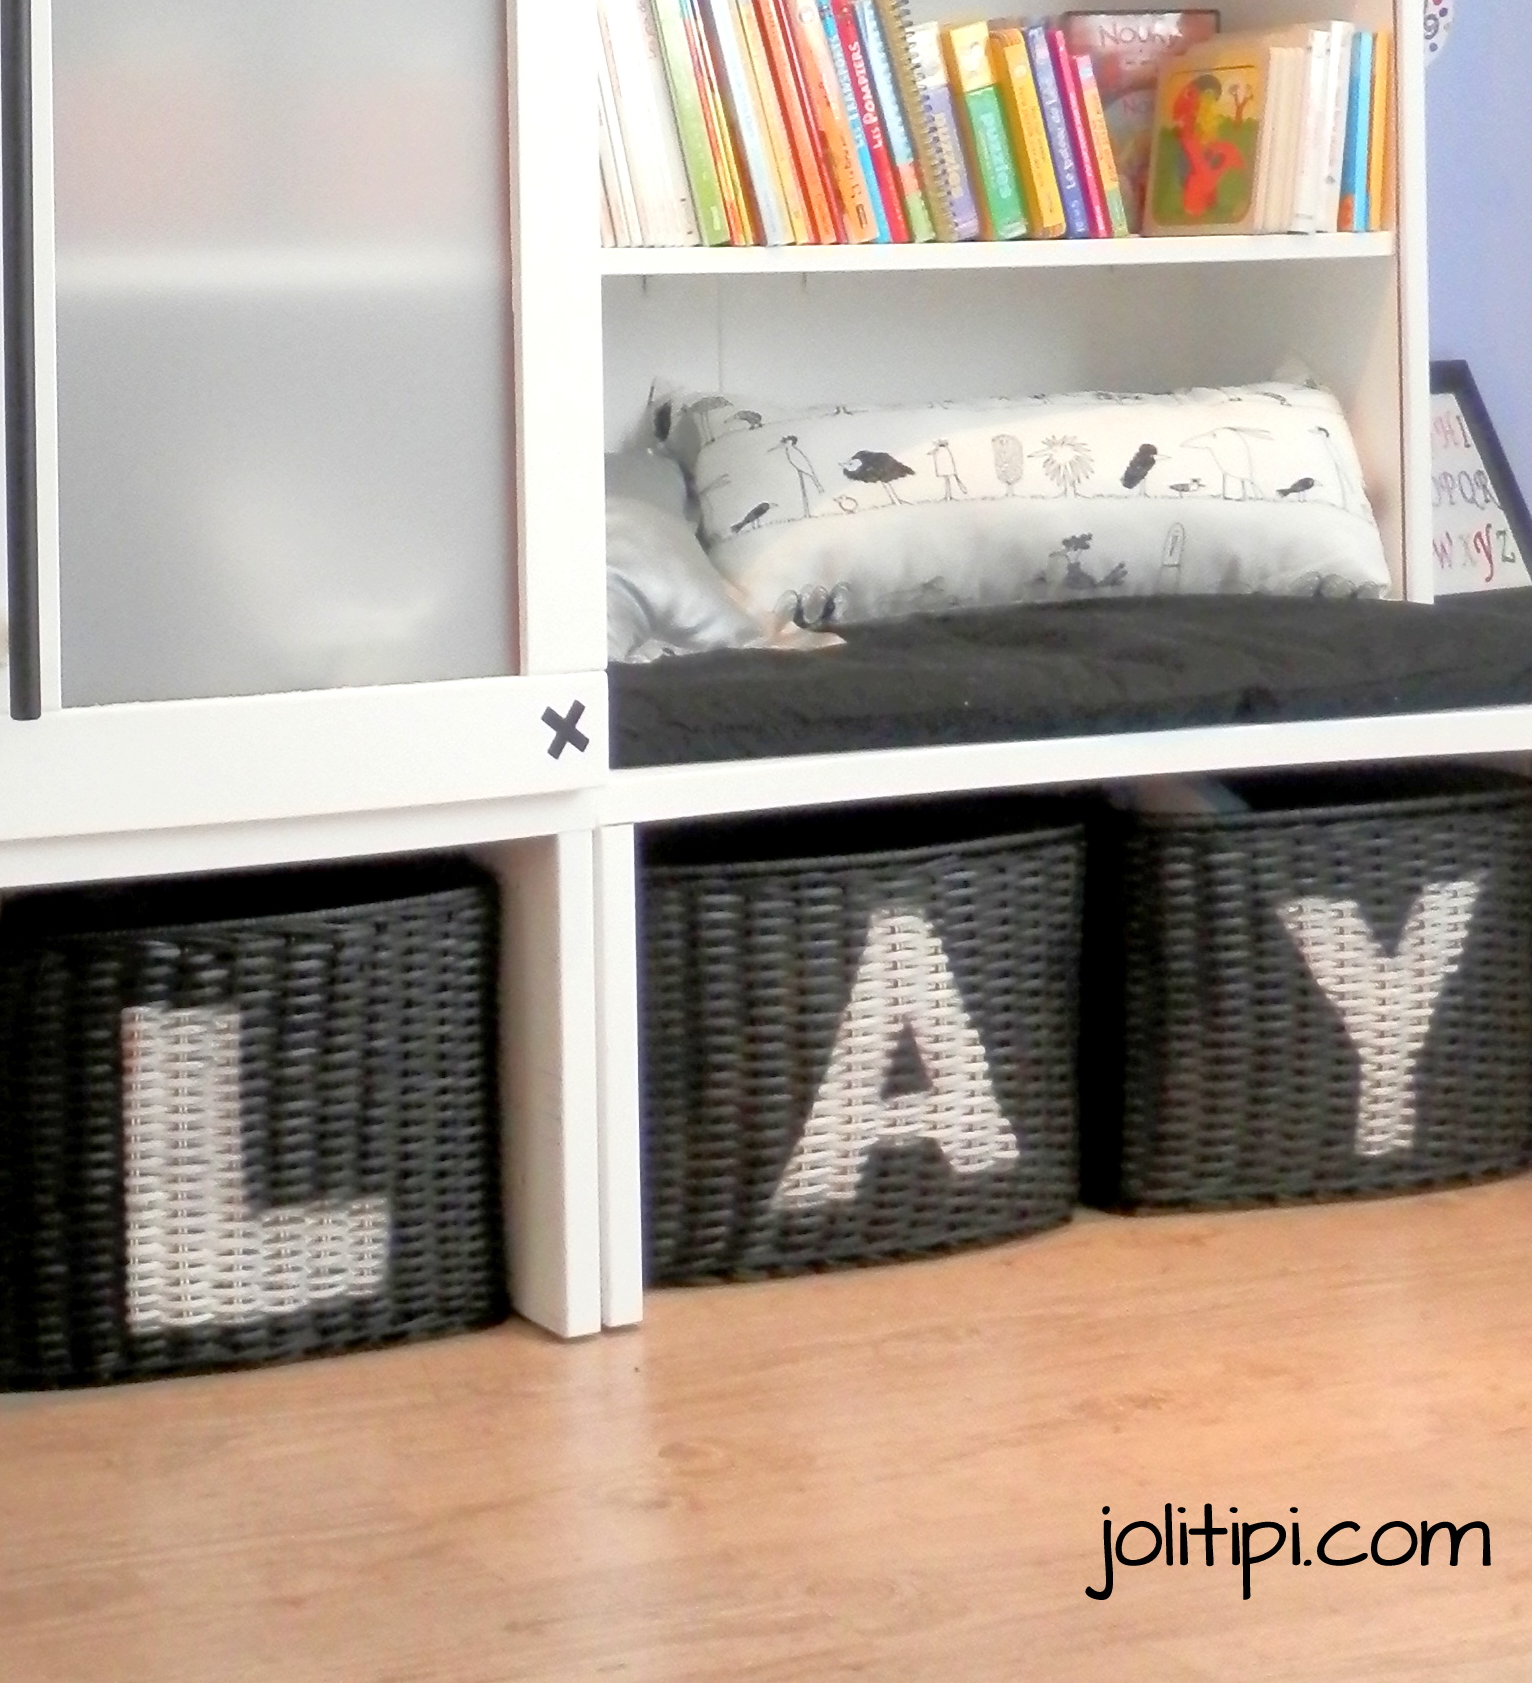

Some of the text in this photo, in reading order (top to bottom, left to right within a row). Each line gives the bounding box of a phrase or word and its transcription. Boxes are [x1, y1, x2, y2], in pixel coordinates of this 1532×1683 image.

[848, 41, 879, 126] POMPIERS
[768, 904, 1021, 1211] A
[1276, 878, 1481, 1157] Y
[121, 1004, 390, 1334] L
